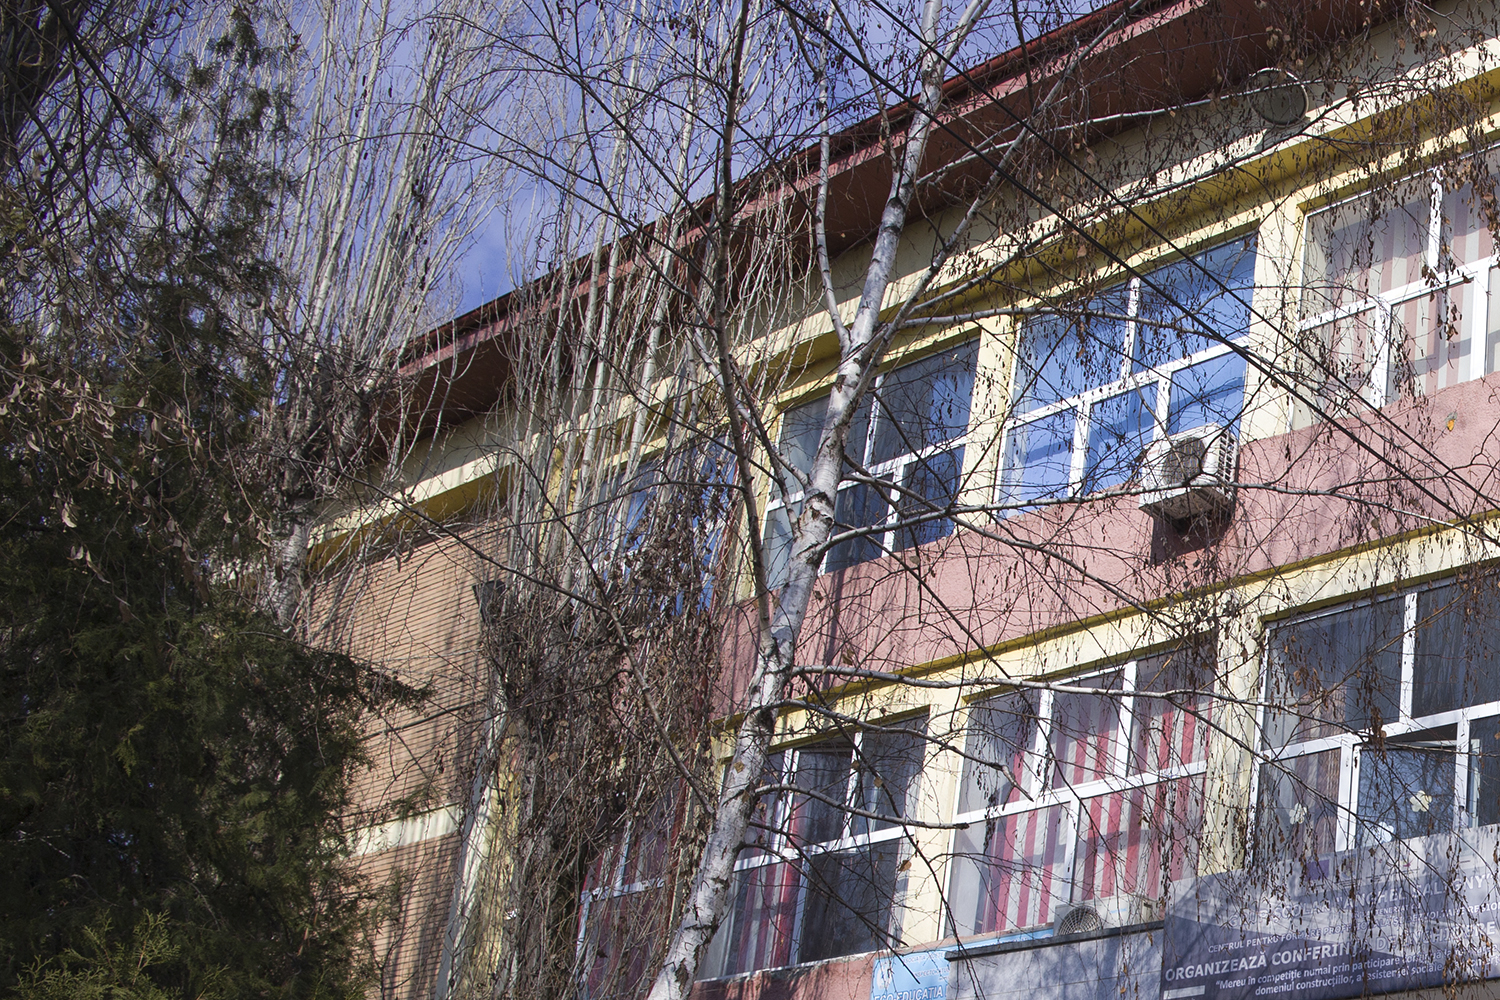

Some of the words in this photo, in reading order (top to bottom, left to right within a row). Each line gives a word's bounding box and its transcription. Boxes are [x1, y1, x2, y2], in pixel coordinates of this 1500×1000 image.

[1164, 951, 1267, 982] ORGANIZEAZĂ
[1303, 964, 1330, 977] numai
[1332, 961, 1350, 975] prin
[1255, 980, 1294, 996] domeniul
